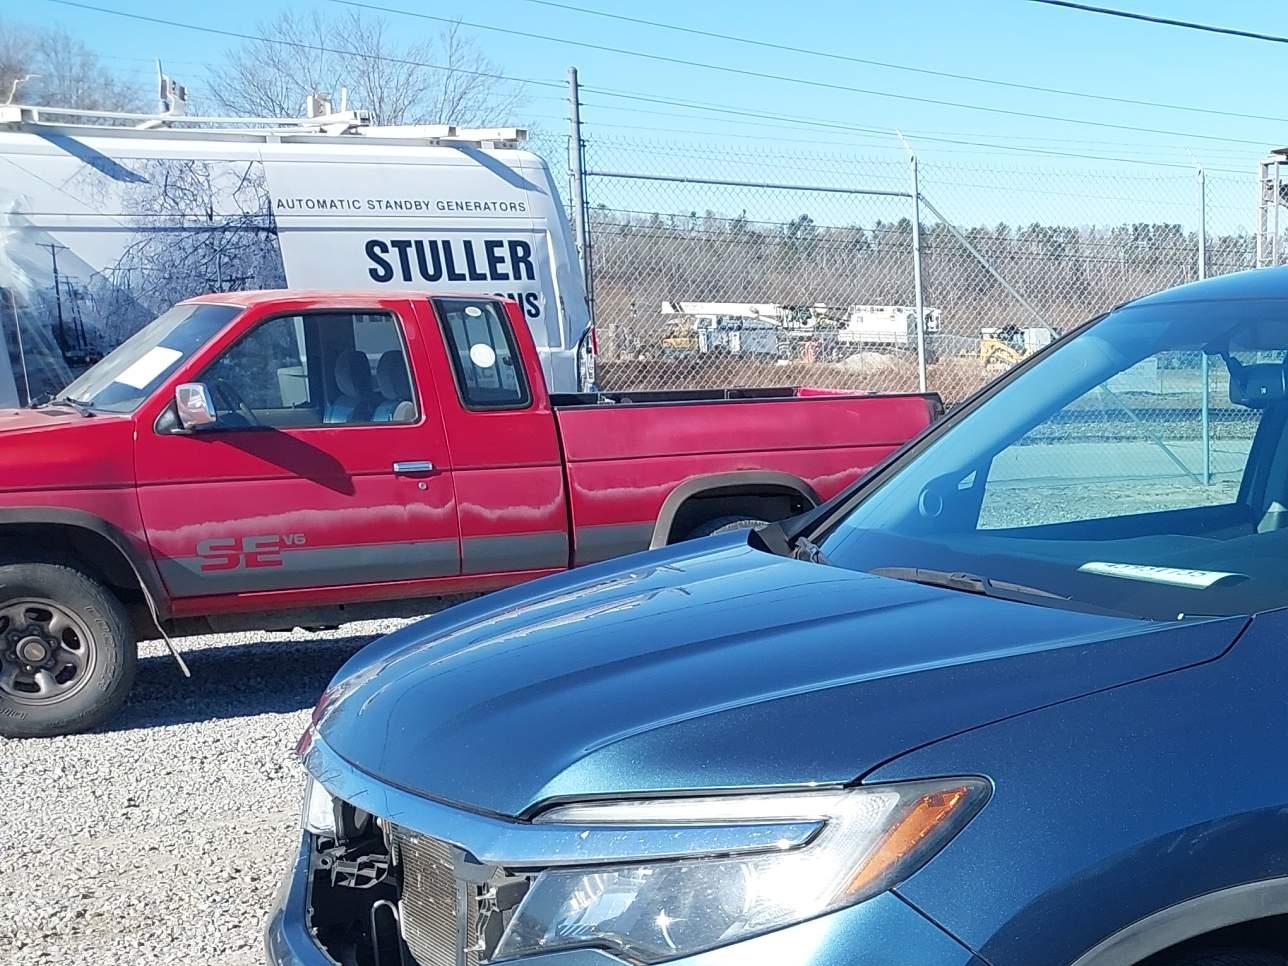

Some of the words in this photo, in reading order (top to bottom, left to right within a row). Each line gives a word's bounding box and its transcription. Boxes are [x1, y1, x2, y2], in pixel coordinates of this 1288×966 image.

[277, 198, 362, 210] AUTOMATIC
[367, 199, 430, 211] STANDBY
[436, 200, 526, 213] GENERATORS
[364, 239, 536, 283] STULLER
[197, 535, 284, 572] SE
